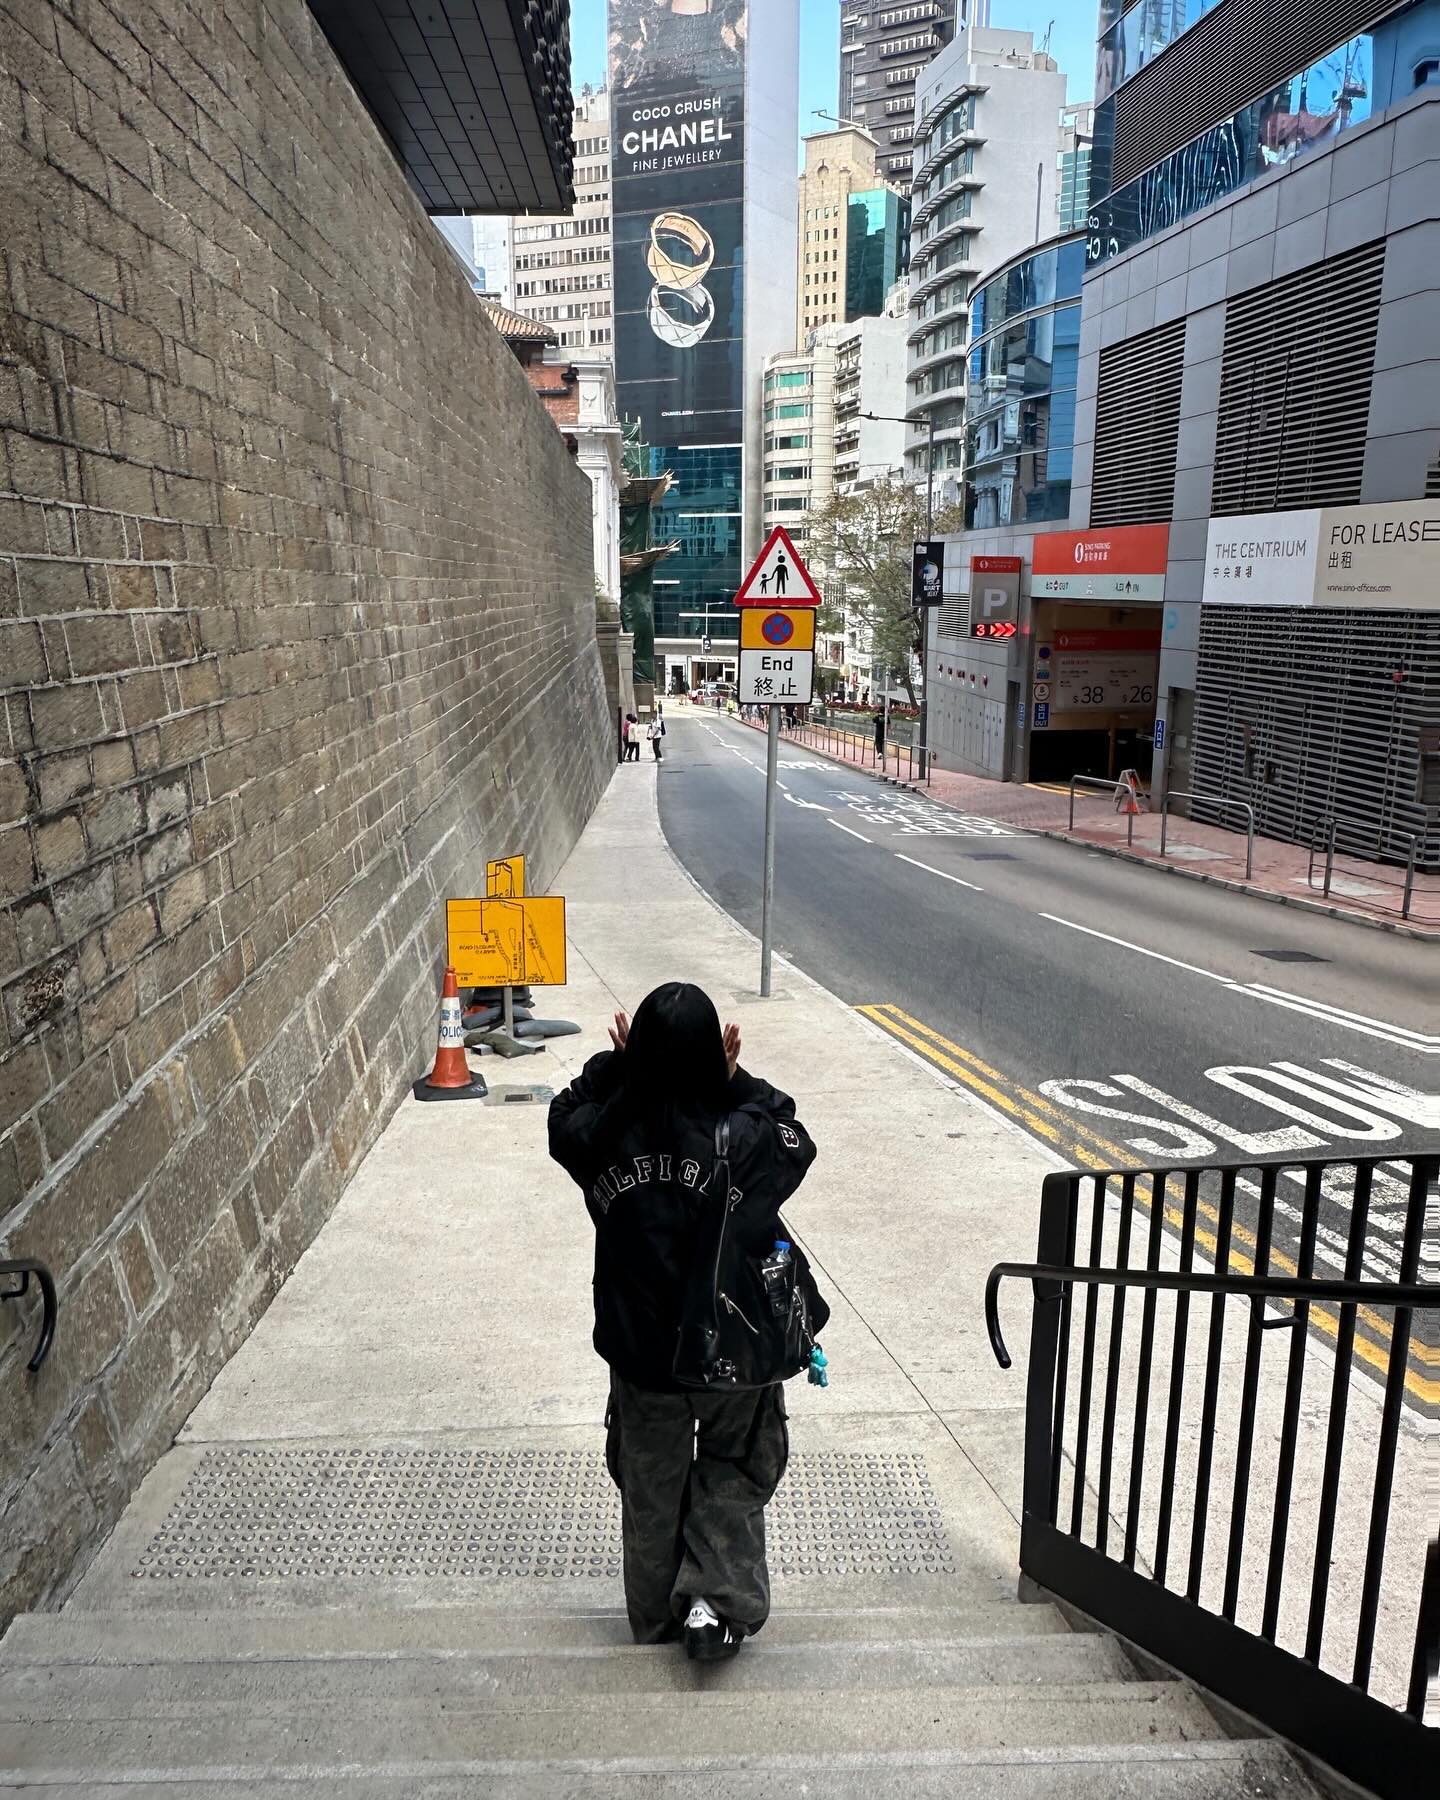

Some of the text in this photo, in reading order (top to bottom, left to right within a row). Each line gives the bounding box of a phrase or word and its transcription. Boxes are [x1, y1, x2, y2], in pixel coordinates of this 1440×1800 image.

[632, 96, 721, 122] COCO CRUSH
[622, 117, 732, 155] CHANEL
[632, 149, 722, 172] FINE JEWELLERY
[1331, 520, 1440, 545] FOR LEASE
[1215, 539, 1307, 559] THE CENTRIUM
[1328, 551, 1352, 569] 出租
[983, 588, 1008, 617] P
[976, 624, 985, 636] 3
[761, 656, 793, 671] End
[753, 677, 798, 697] 終止
[858, 814, 997, 826] CLEAR
[899, 824, 1016, 835] KEEP
